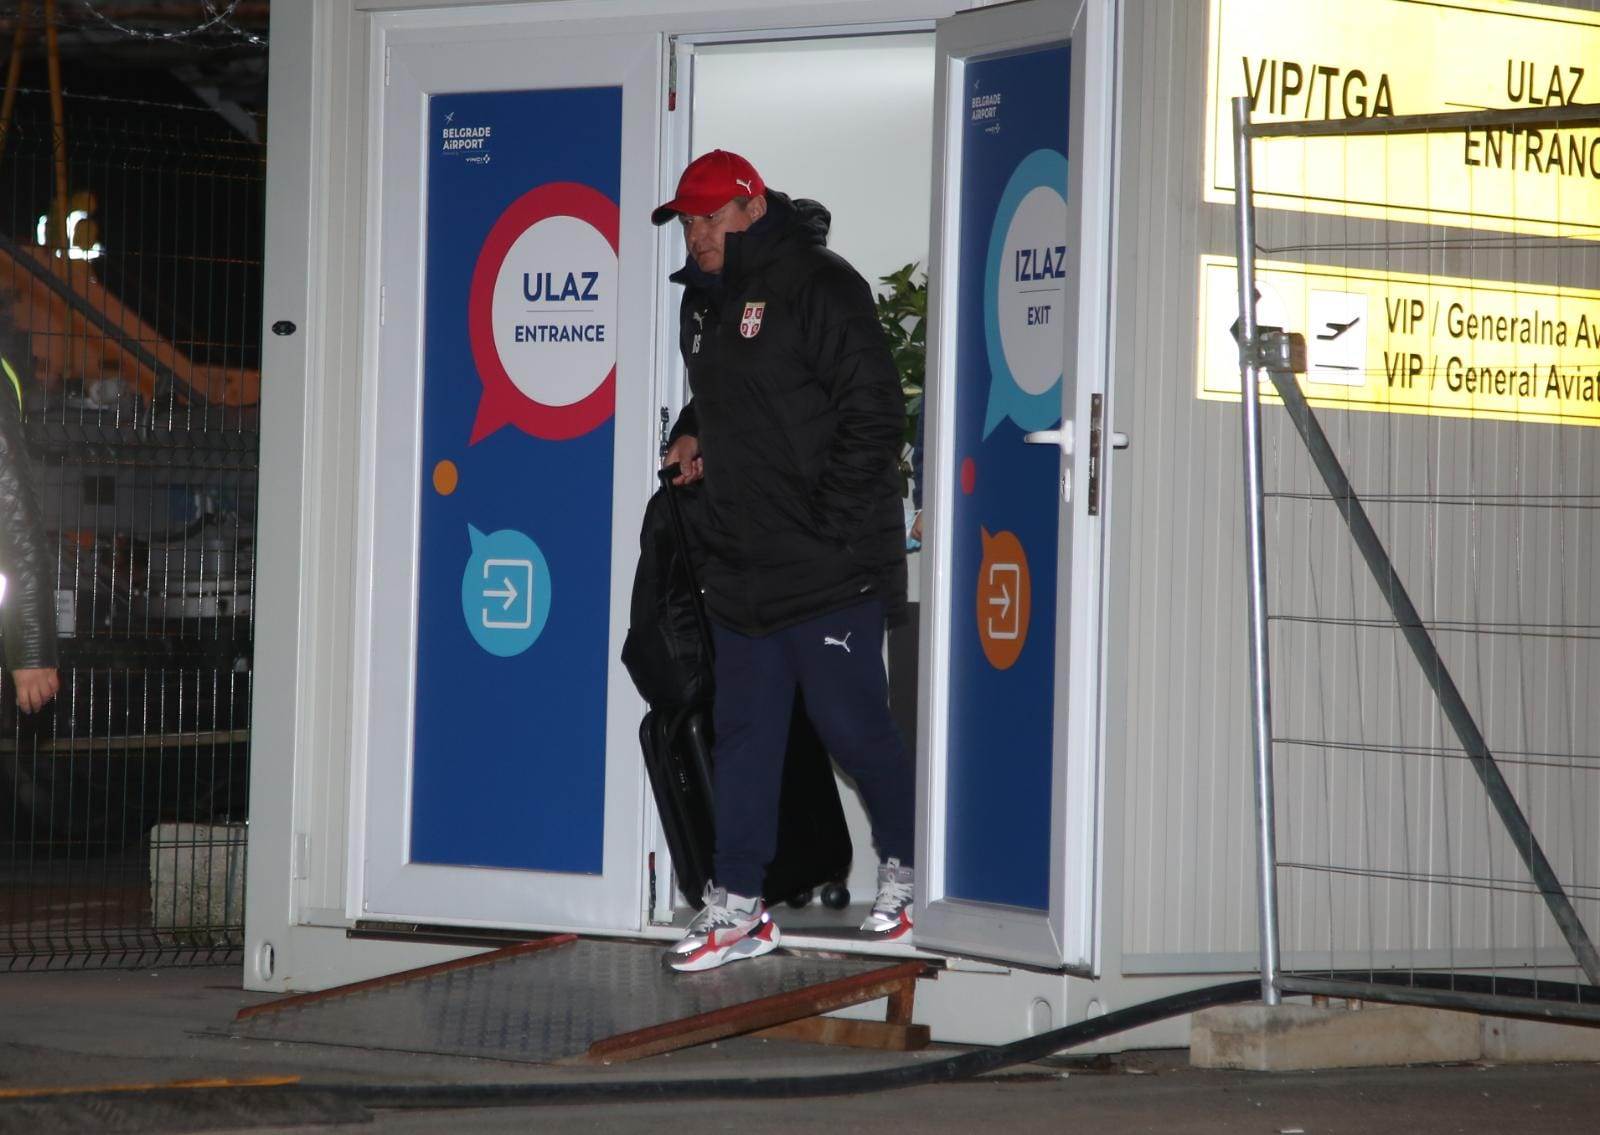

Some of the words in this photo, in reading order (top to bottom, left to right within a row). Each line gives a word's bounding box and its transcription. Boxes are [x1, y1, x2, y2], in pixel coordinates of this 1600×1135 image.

[1242, 56, 1395, 121] VIP/TGA
[1507, 59, 1585, 106] ULAZ
[971, 93, 1001, 108] BELGRADE
[971, 106, 997, 121] AIRPORT
[442, 127, 491, 139] BELGRADE
[442, 139, 484, 151] AIRPORT
[1015, 246, 1066, 282] IZLAZ
[523, 271, 599, 302] ULAZ
[1027, 305, 1052, 326] EXIT
[1385, 297, 1424, 336] VIP
[1447, 302, 1567, 347] Generalna
[514, 324, 605, 343] ENTRANCE
[1383, 351, 1424, 389] VIP
[1445, 356, 1537, 397] General
